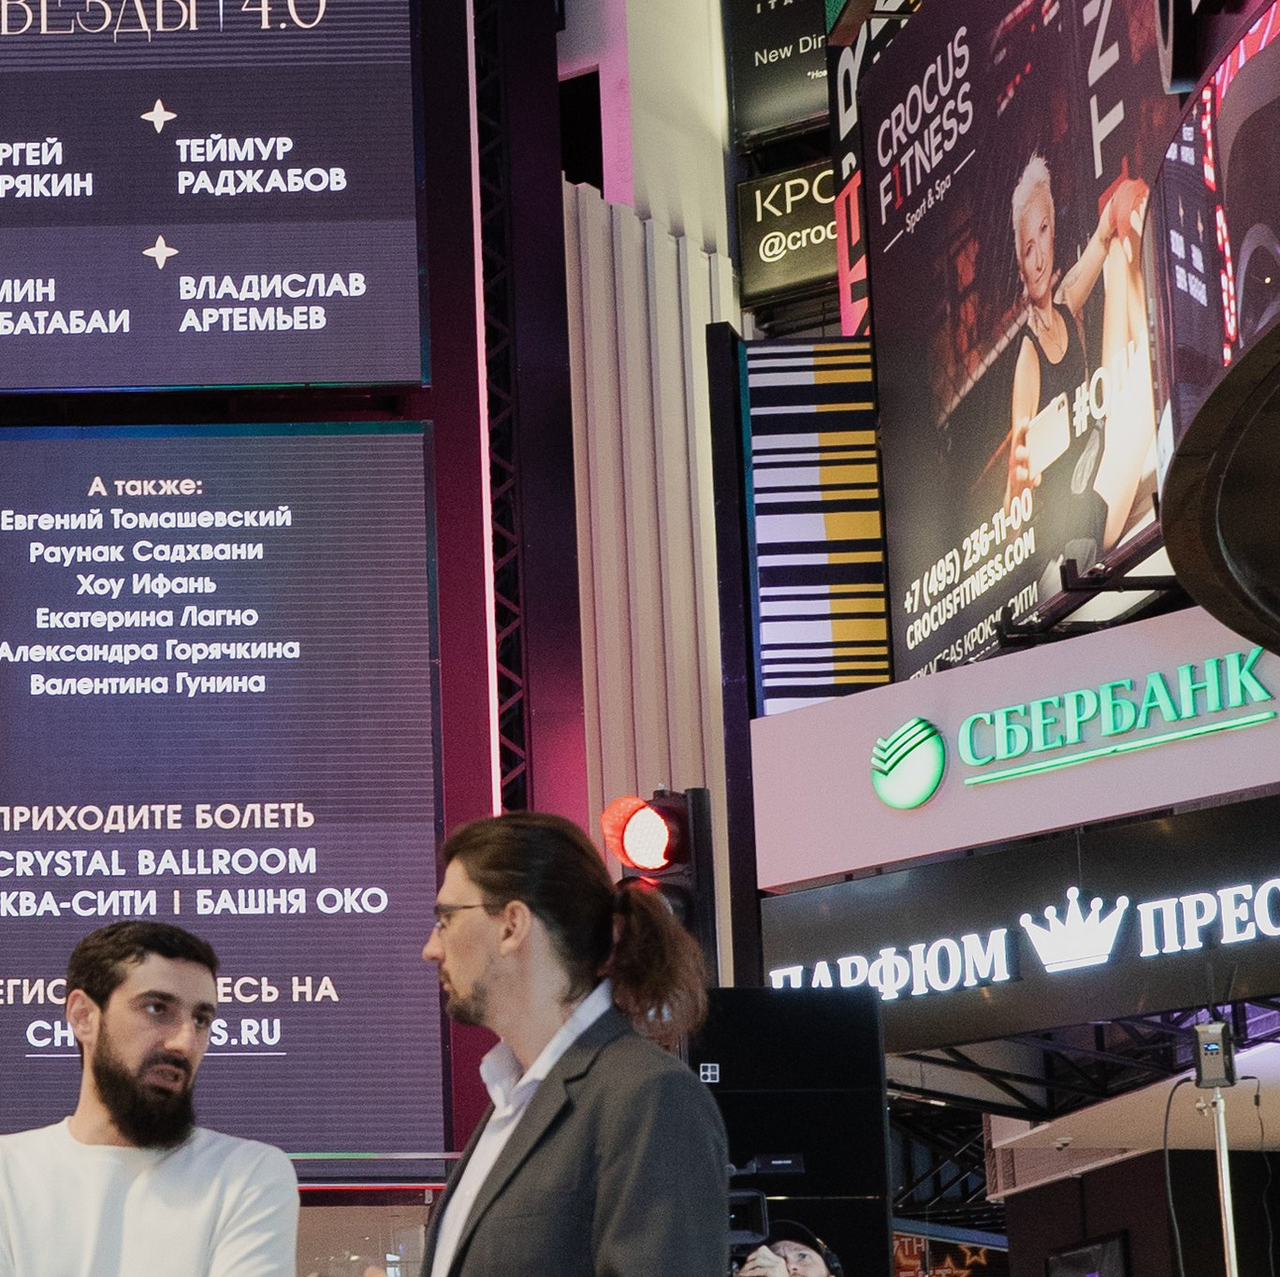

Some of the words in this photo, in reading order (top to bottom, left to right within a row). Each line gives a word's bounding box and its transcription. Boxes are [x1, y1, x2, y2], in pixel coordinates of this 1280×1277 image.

[754, 44, 793, 67] New
[876, 25, 969, 168] CROCUS
[175, 133, 294, 163] ТЕЙМУР
[177, 167, 347, 197] РАДЖАБОВ
[179, 272, 367, 301] ВЛАДИСЛАВ
[178, 305, 327, 333] АРТЕМЬЕВ
[87, 476, 108, 497] А
[113, 478, 203, 496] также:
[0, 508, 104, 531] Евгений
[110, 505, 292, 530] Томашевский
[29, 541, 125, 567] Раунак
[132, 540, 264, 563] Садхвани
[76, 573, 126, 600] Хоу
[132, 572, 217, 599] Ифань
[906, 527, 1036, 651] CROCUSFITNESS.COM
[922, 548, 961, 607] (495)
[36, 607, 174, 632] Екатерина
[179, 605, 259, 627] Лагно
[165, 639, 301, 664] Горячкина
[30, 673, 169, 696] Валентина
[176, 671, 266, 698] Гунина
[957, 645, 1272, 767] СБЕРБАНК
[195, 802, 315, 830] БОЛЕТЬ
[137, 847, 317, 876] BALLROOM
[196, 888, 307, 915] БАШНЯ
[316, 887, 389, 914] ОКО
[291, 975, 340, 1002] НА
